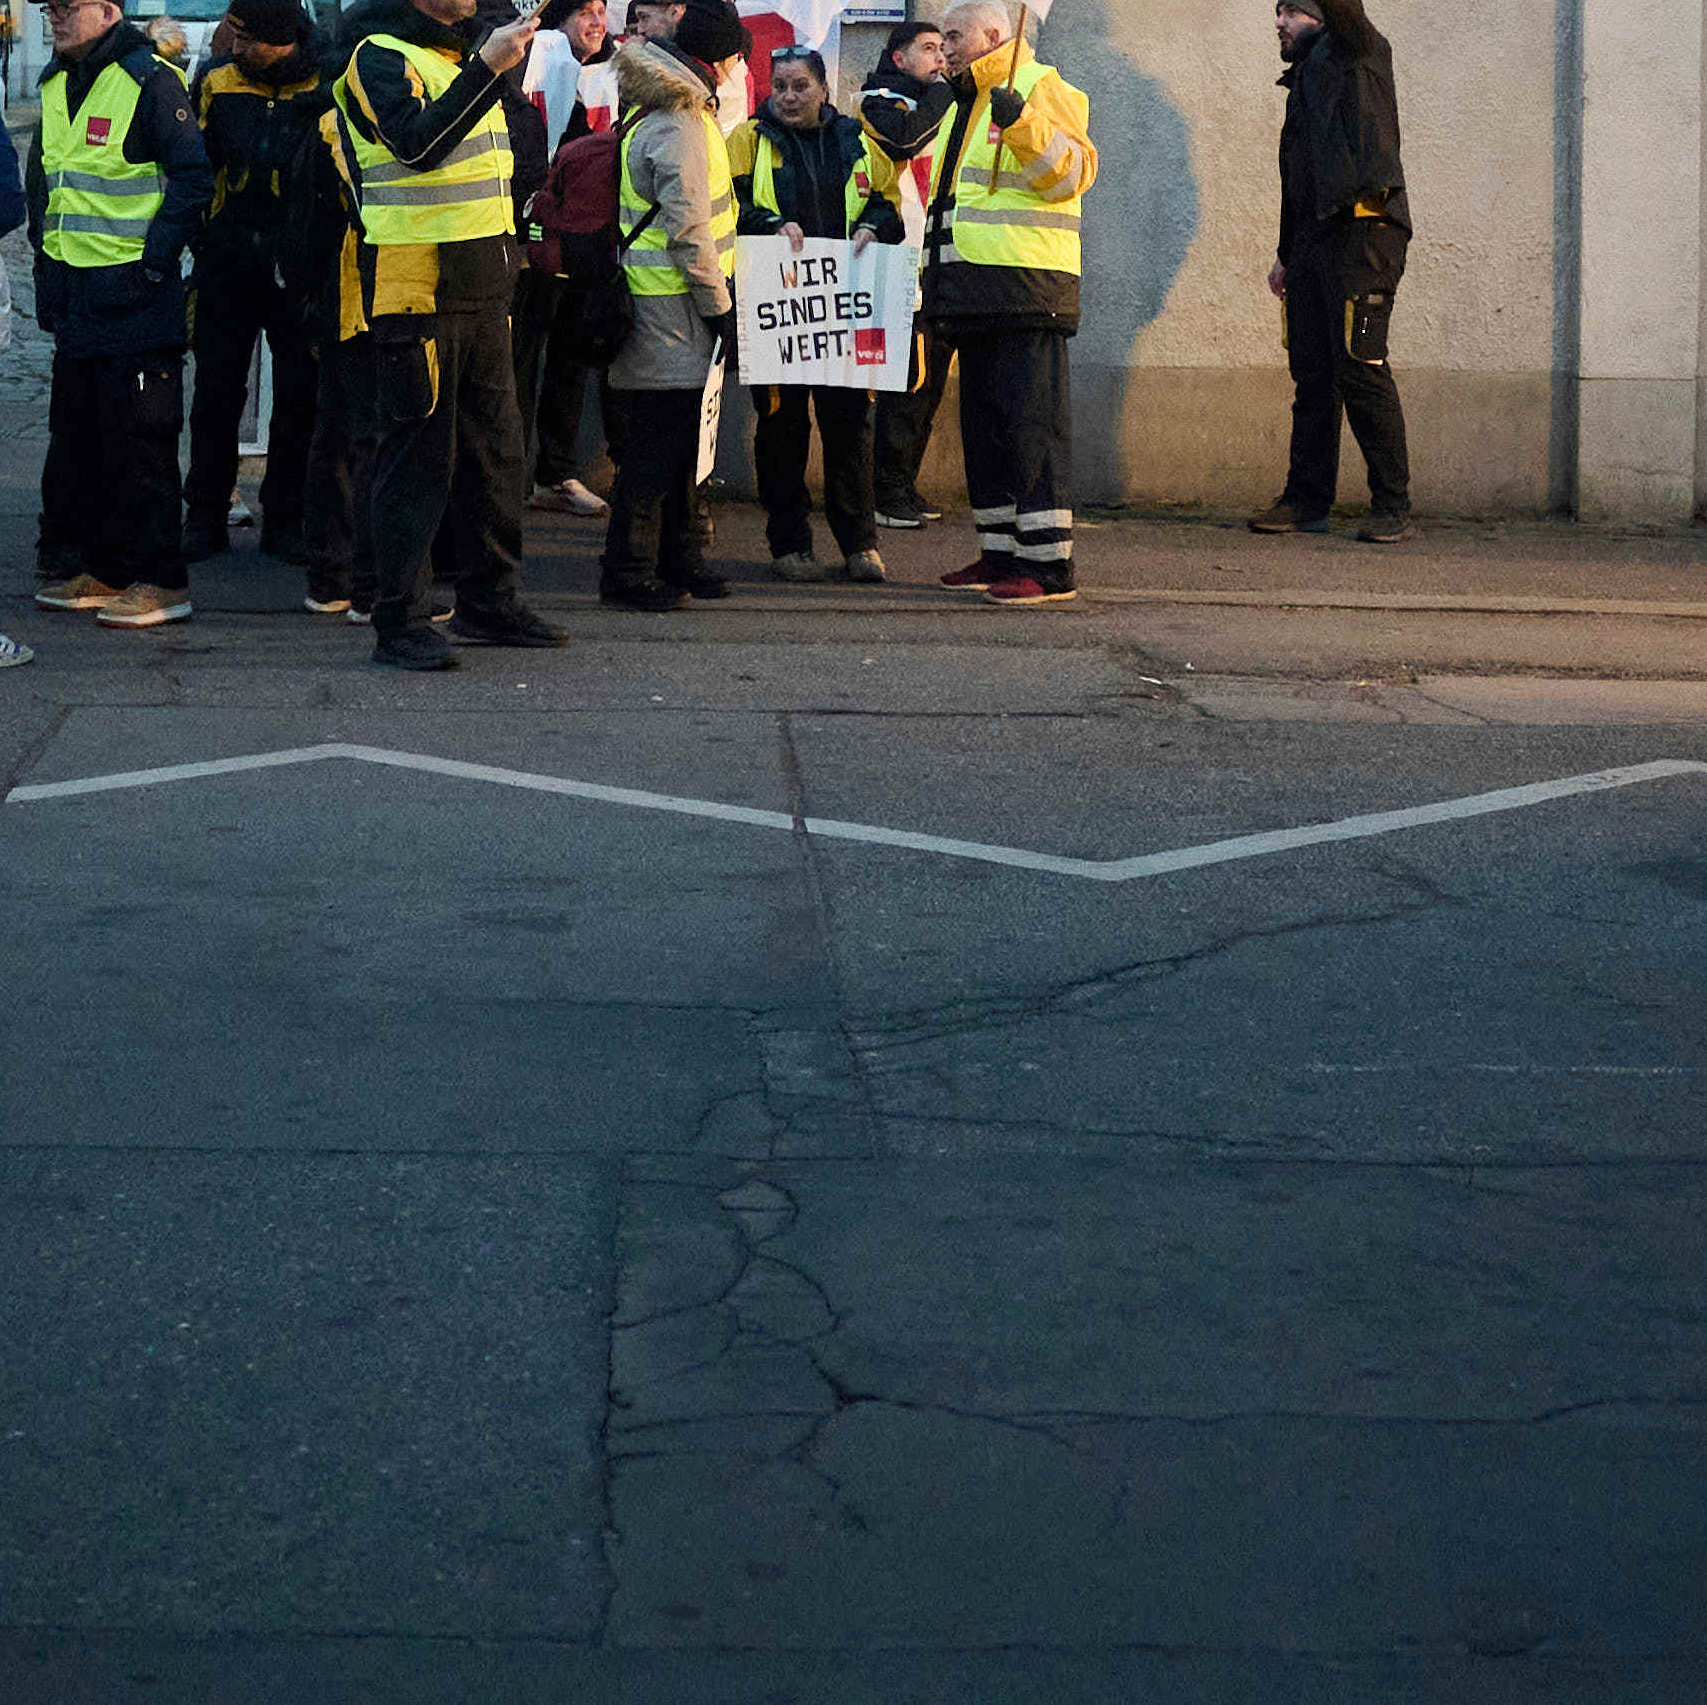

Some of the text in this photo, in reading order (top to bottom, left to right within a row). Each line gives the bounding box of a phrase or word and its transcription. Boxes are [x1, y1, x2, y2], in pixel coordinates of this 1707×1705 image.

[779, 257, 838, 289] WIR
[757, 292, 873, 330] SIND ES
[778, 329, 851, 364] WERT.
